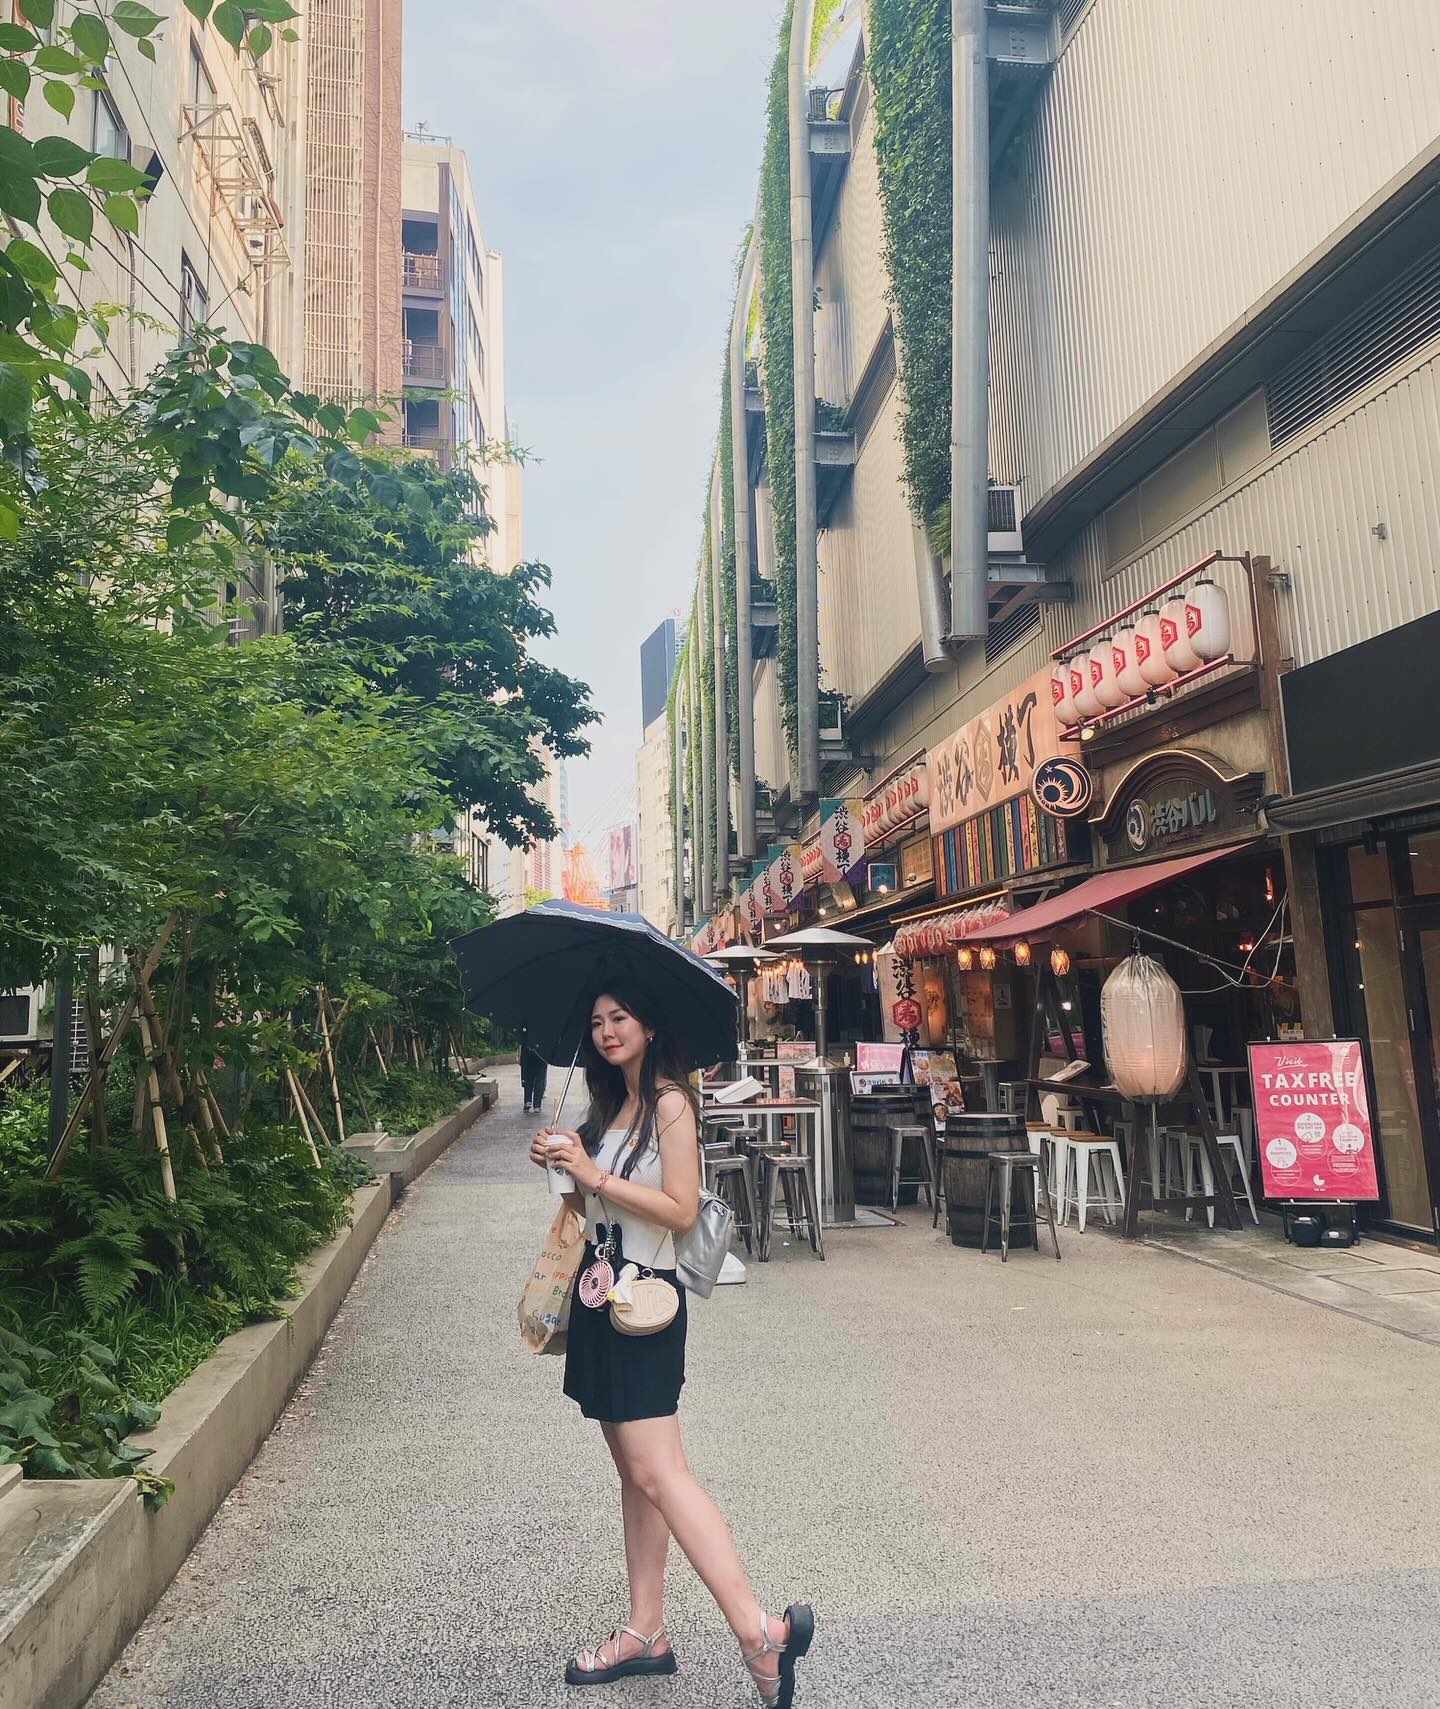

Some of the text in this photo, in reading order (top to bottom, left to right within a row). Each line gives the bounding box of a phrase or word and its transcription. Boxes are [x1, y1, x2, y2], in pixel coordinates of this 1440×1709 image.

[1150, 789, 1217, 839] 渋谷バル
[1274, 1056, 1305, 1068] Visit
[1269, 1093, 1350, 1107] COUNTER
